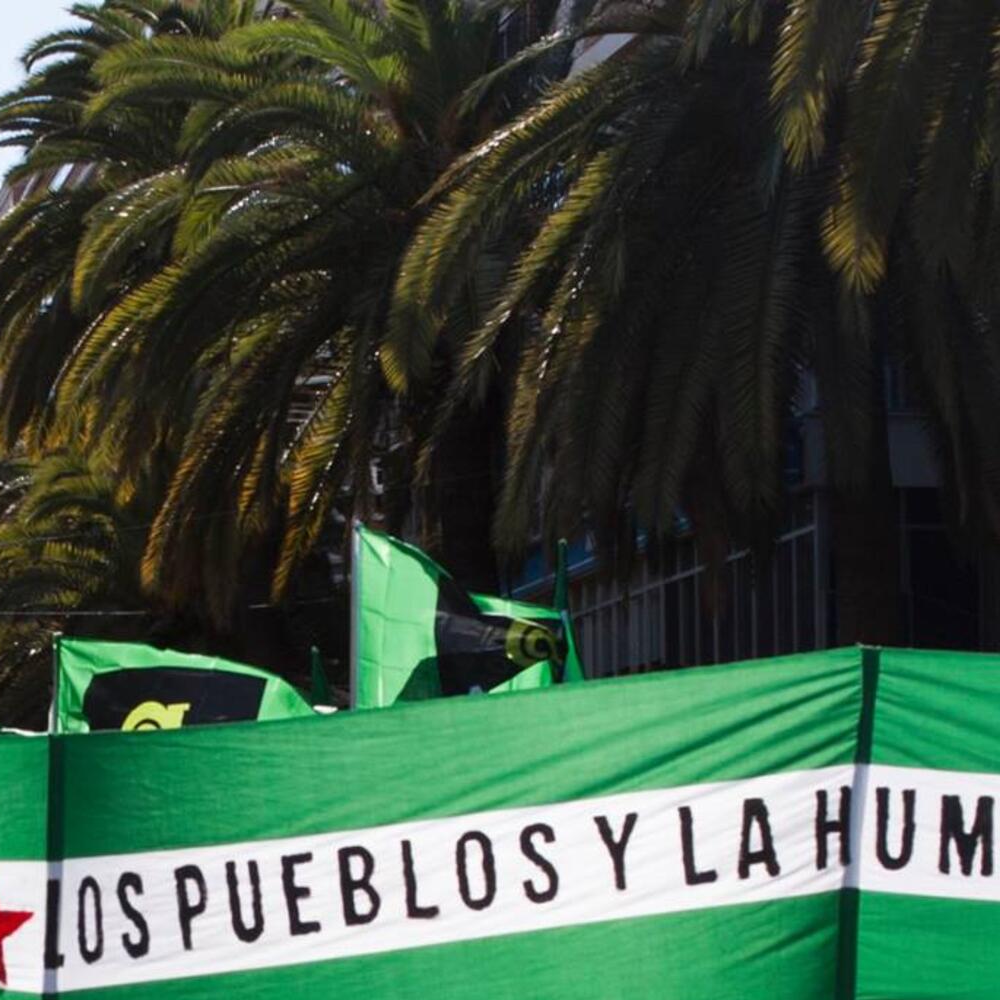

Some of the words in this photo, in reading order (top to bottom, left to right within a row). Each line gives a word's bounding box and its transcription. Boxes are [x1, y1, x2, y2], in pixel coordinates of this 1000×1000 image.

[43, 871, 150, 971] LOS
[174, 823, 560, 951] PUEBLOS
[593, 812, 638, 891] Y
[678, 798, 781, 887] LA
[815, 785, 994, 877] HUM
